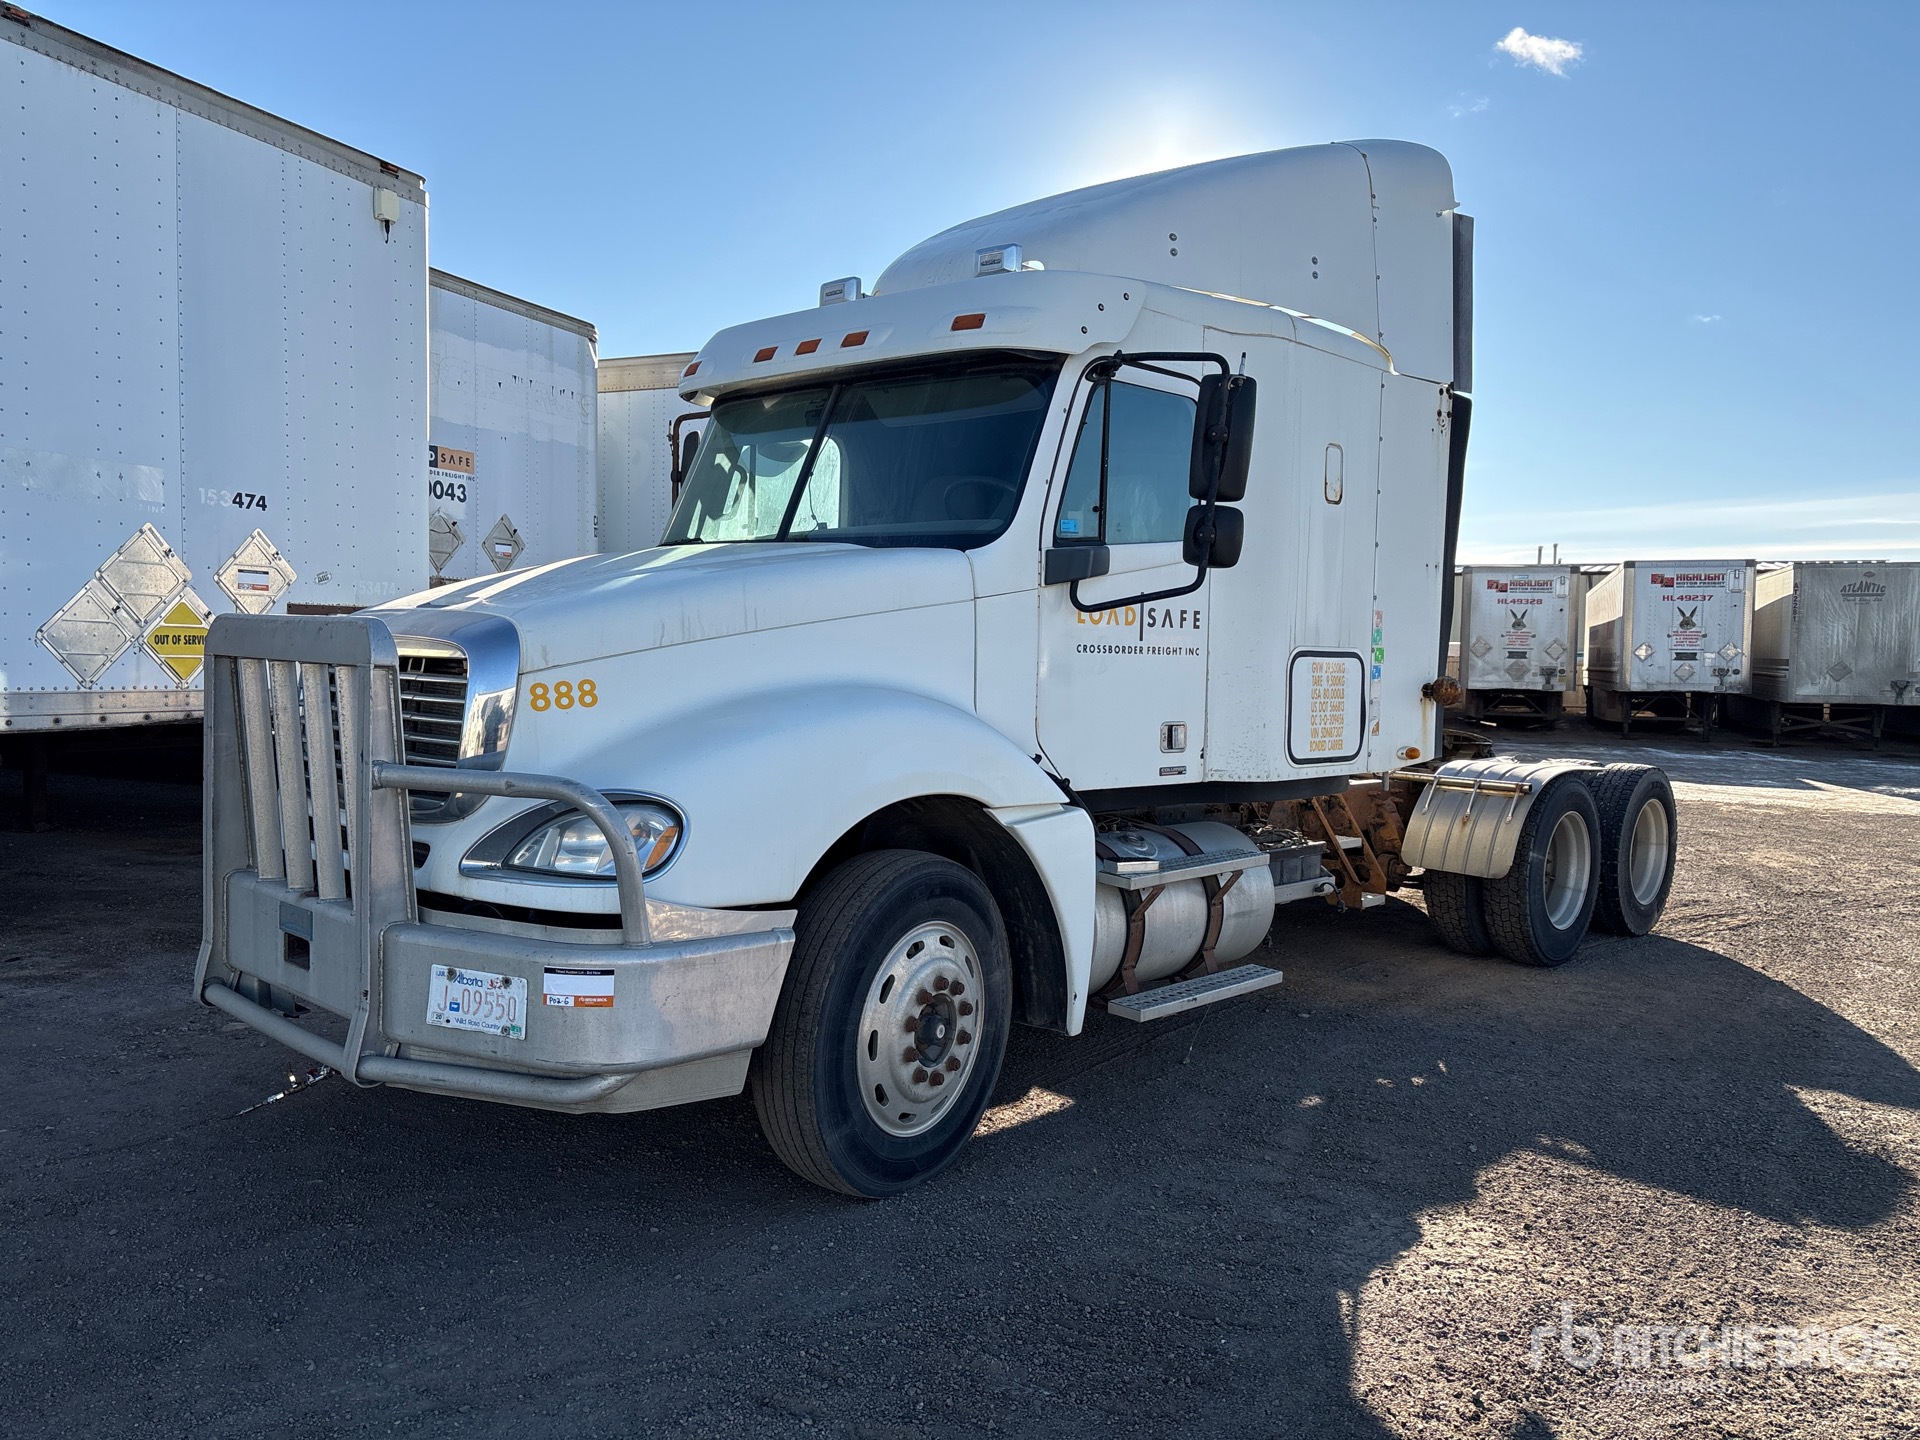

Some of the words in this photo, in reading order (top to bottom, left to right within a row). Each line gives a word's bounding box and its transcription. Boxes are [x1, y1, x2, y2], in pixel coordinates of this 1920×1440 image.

[440, 452, 471, 468] SAFE
[429, 469, 440, 477] DER
[441, 471, 465, 481] FREIGHT
[1676, 573, 1726, 581] HIGHLIGHT
[1840, 581, 1887, 592] ATLANTIC
[1662, 594, 1714, 602] HL49237
[1147, 607, 1200, 630] SAFE
[154, 634, 170, 645] OUT
[171, 634, 182, 646] OF
[183, 634, 205, 646] SERVI
[1076, 643, 1144, 655] CROSSBORDER
[1146, 646, 1182, 656] FREIGHT
[1185, 647, 1200, 656] INC
[1311, 662, 1324, 674] GVW
[1311, 675, 1323, 687] TARE
[529, 678, 599, 712] 888
[1311, 688, 1322, 700] USA
[1310, 701, 1318, 713] US
[1319, 701, 1329, 713] DOT
[1310, 727, 1320, 739] VIN
[1309, 740, 1327, 752] BONDED
[1327, 740, 1344, 751] CARRIER
[453, 971, 483, 988] Alberta
[437, 985, 448, 1012] J
[461, 988, 517, 1023] 09550
[468, 1019, 480, 1027] Rose
[481, 1021, 501, 1031] Country
